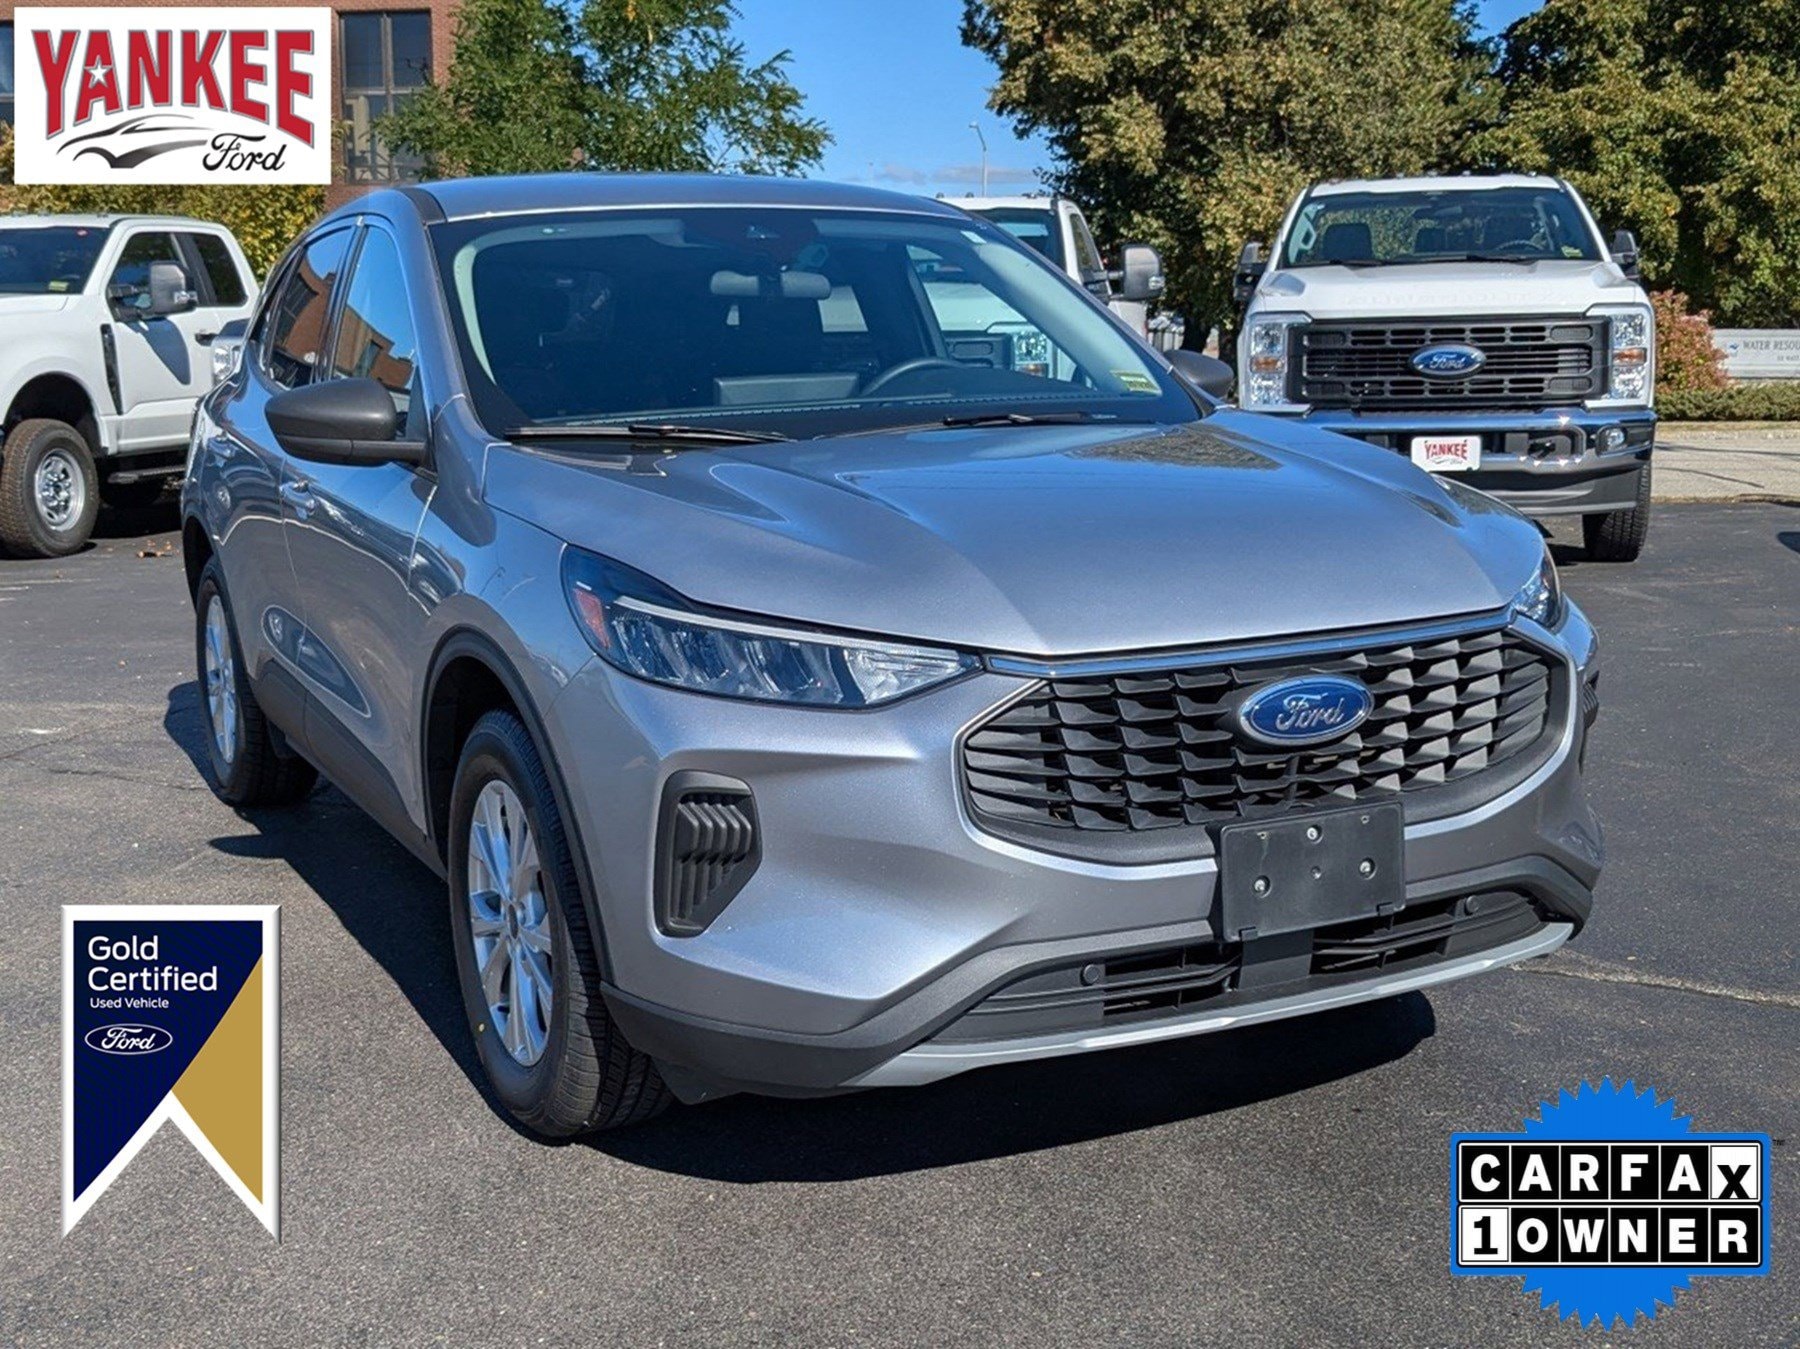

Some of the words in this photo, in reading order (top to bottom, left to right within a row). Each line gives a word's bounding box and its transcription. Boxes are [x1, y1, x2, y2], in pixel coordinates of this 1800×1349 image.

[1743, 340, 1770, 350] WATER
[1429, 353, 1466, 369] Ford
[1424, 443, 1468, 460] YANKEE
[1275, 692, 1345, 731] Ford
